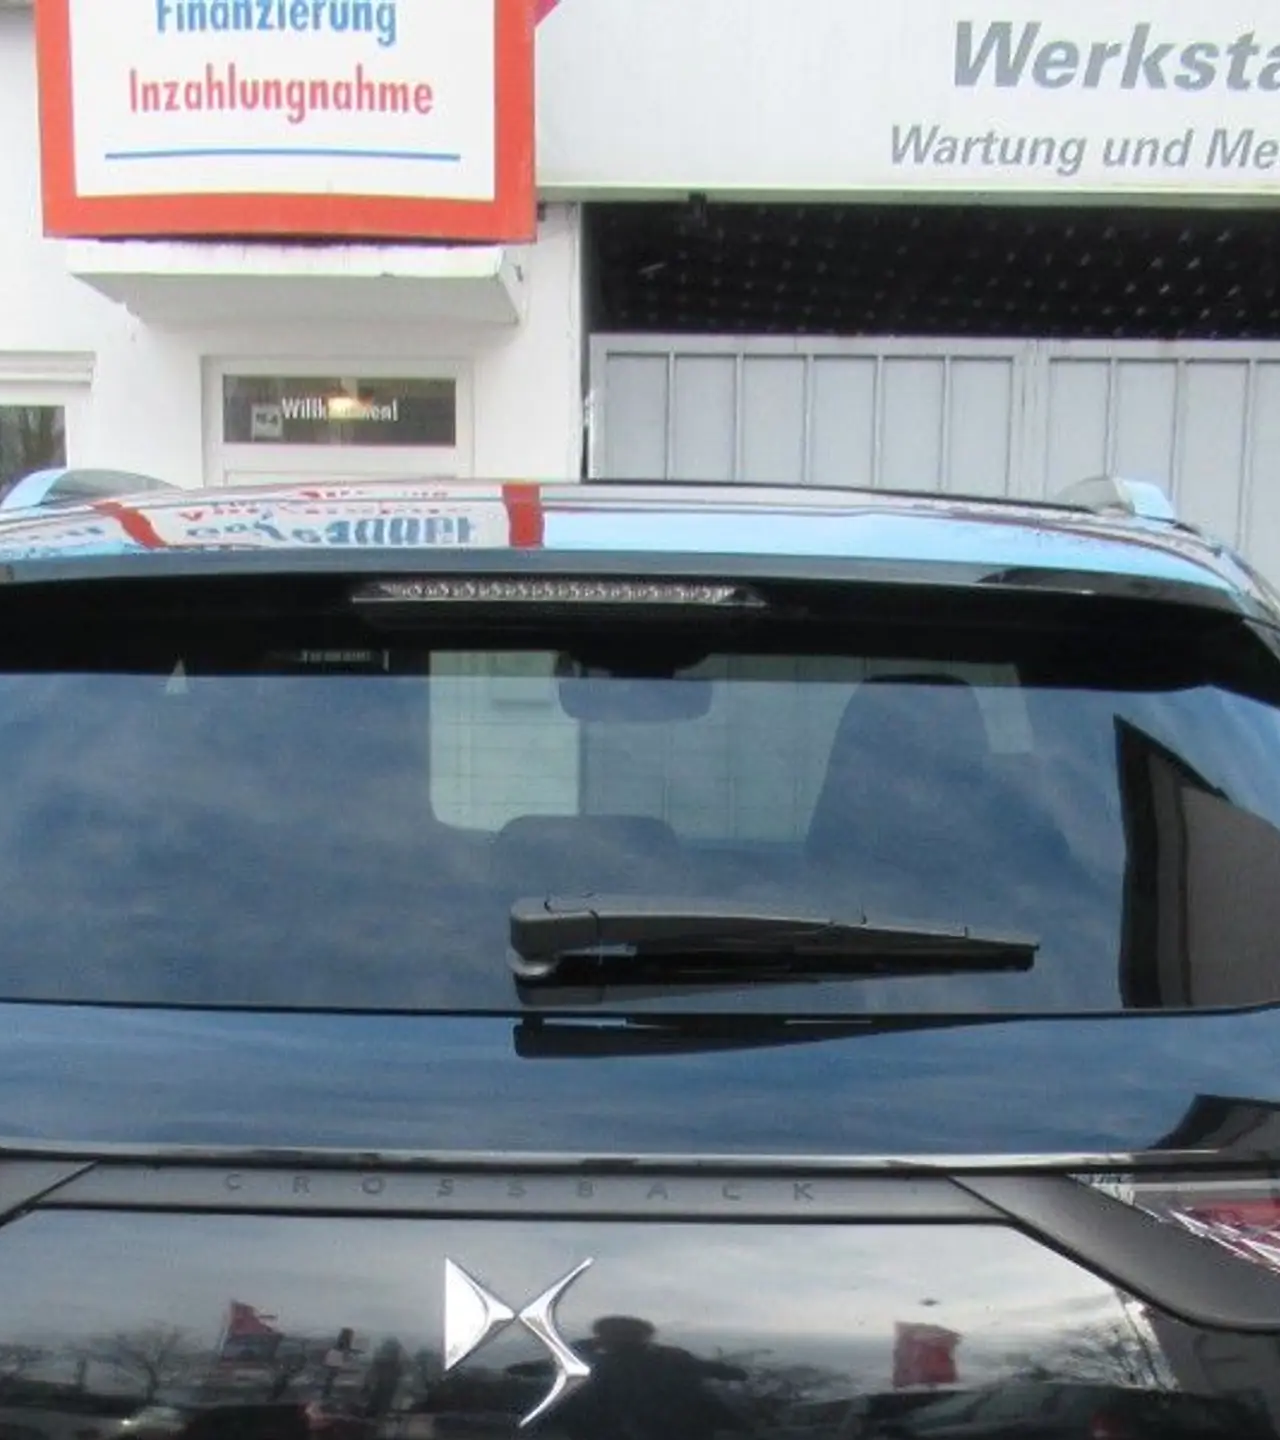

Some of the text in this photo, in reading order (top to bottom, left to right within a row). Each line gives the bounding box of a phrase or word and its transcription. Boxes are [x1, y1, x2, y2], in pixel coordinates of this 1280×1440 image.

[156, 0, 397, 47] Finanzierung
[129, 63, 433, 124] Inzahlungnahme
[891, 124, 1087, 176] Wartung
[1103, 128, 1194, 168] und
[224, 1171, 815, 1202] CROSSBACK
